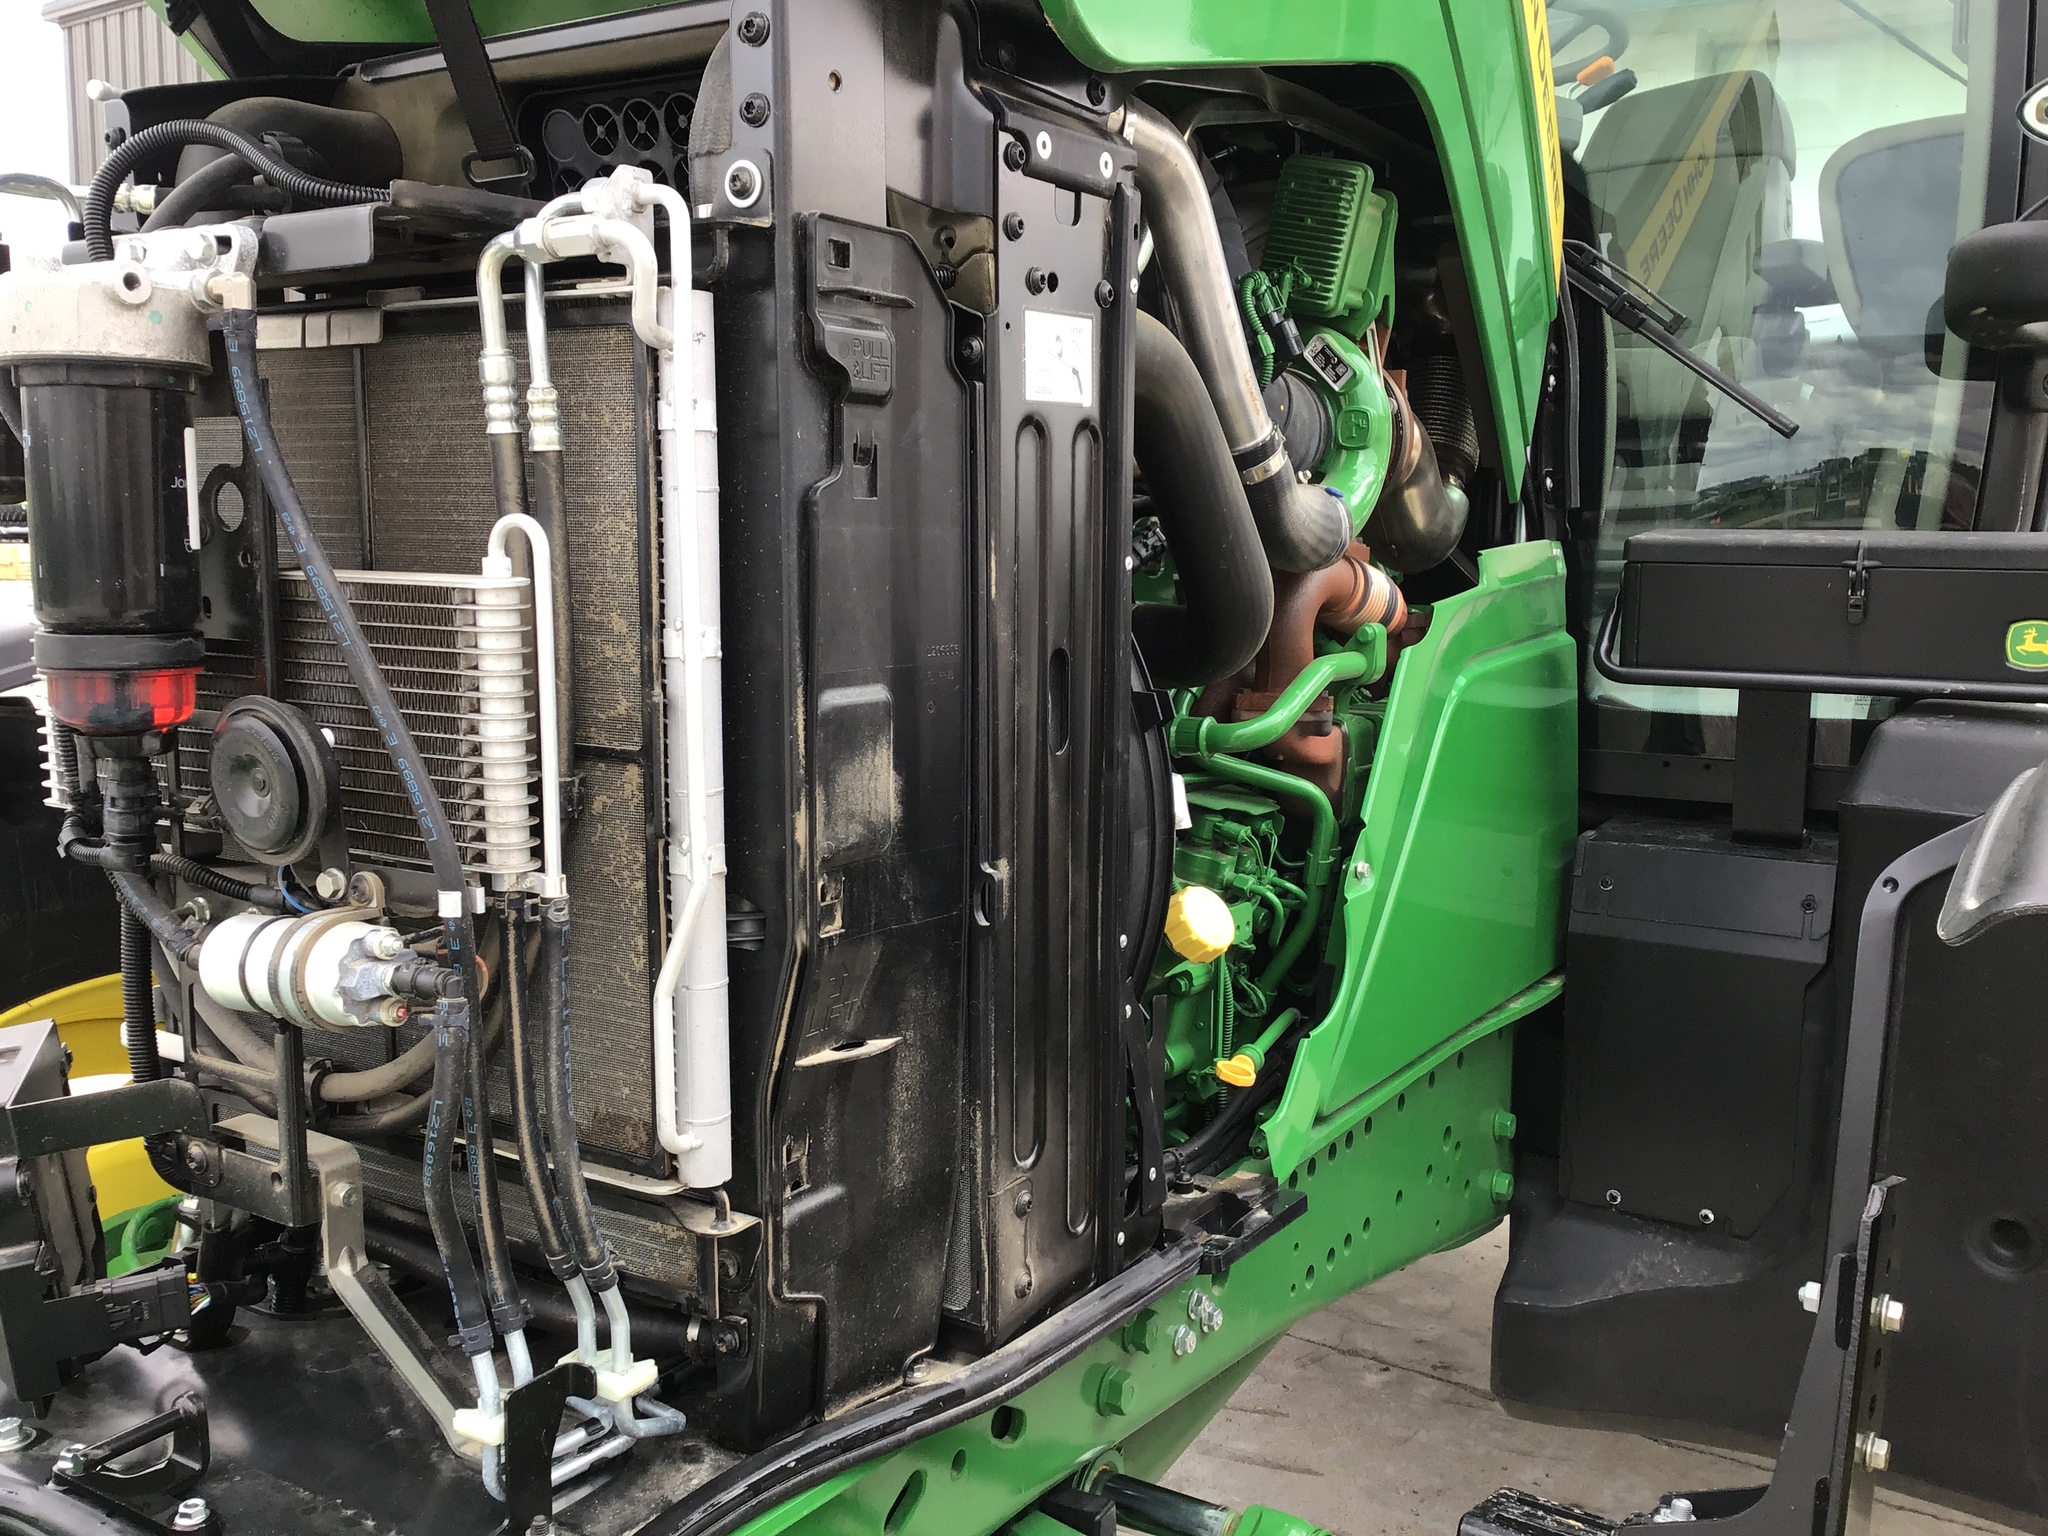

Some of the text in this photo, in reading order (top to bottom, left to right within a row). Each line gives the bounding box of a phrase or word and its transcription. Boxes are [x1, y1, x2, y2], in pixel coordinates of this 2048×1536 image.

[1537, 24, 1559, 226] DEERE
[852, 337, 889, 361] PULL
[852, 361, 891, 384] &LIFT
[228, 340, 263, 453] L215899 E
[170, 476, 187, 488] Jo
[281, 511, 350, 648] L215899 E 49/23
[371, 704, 438, 843] L215899 E 49/23
[806, 997, 860, 1038] LIFT
